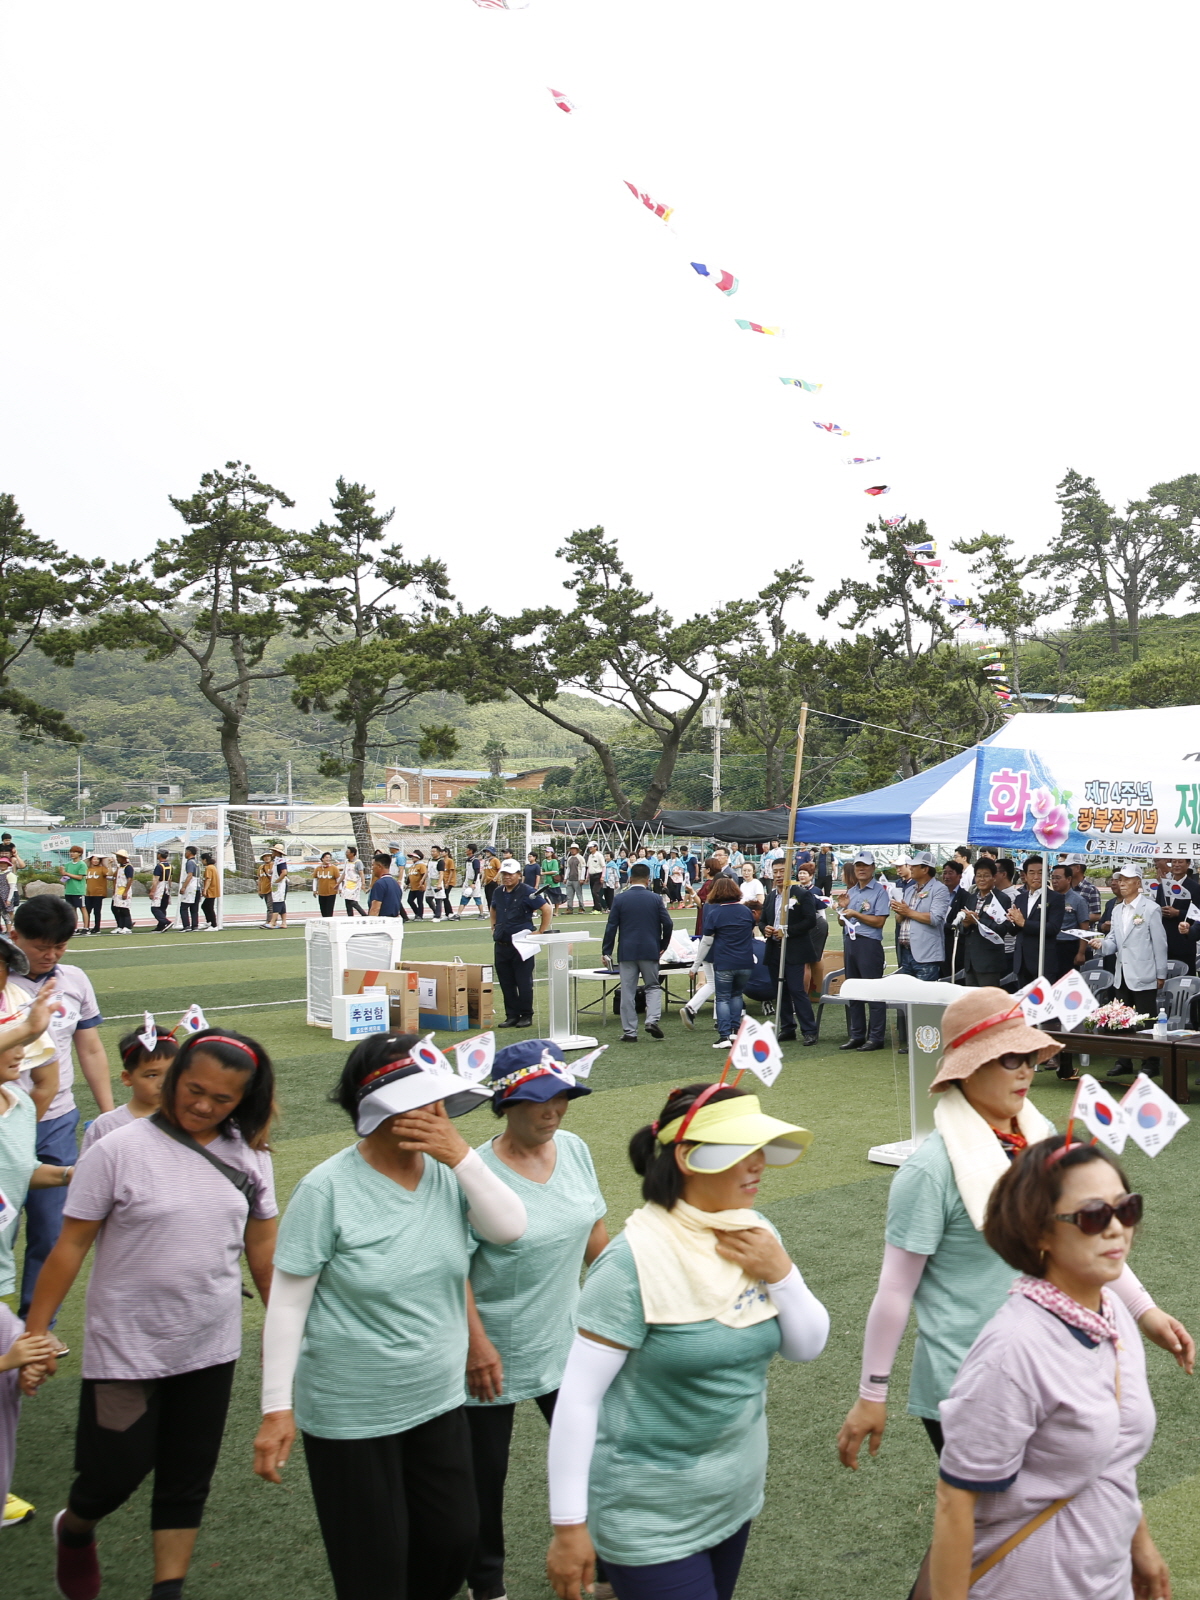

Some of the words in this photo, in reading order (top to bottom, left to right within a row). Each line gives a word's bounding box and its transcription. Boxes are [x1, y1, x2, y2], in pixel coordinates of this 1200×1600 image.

[986, 769, 1031, 830] 화
[1085, 780, 1153, 806] 제74주년
[1077, 807, 1158, 834] 광복절기념
[1126, 843, 1154, 854] Jindo
[352, 1006, 384, 1022] 추첨함
